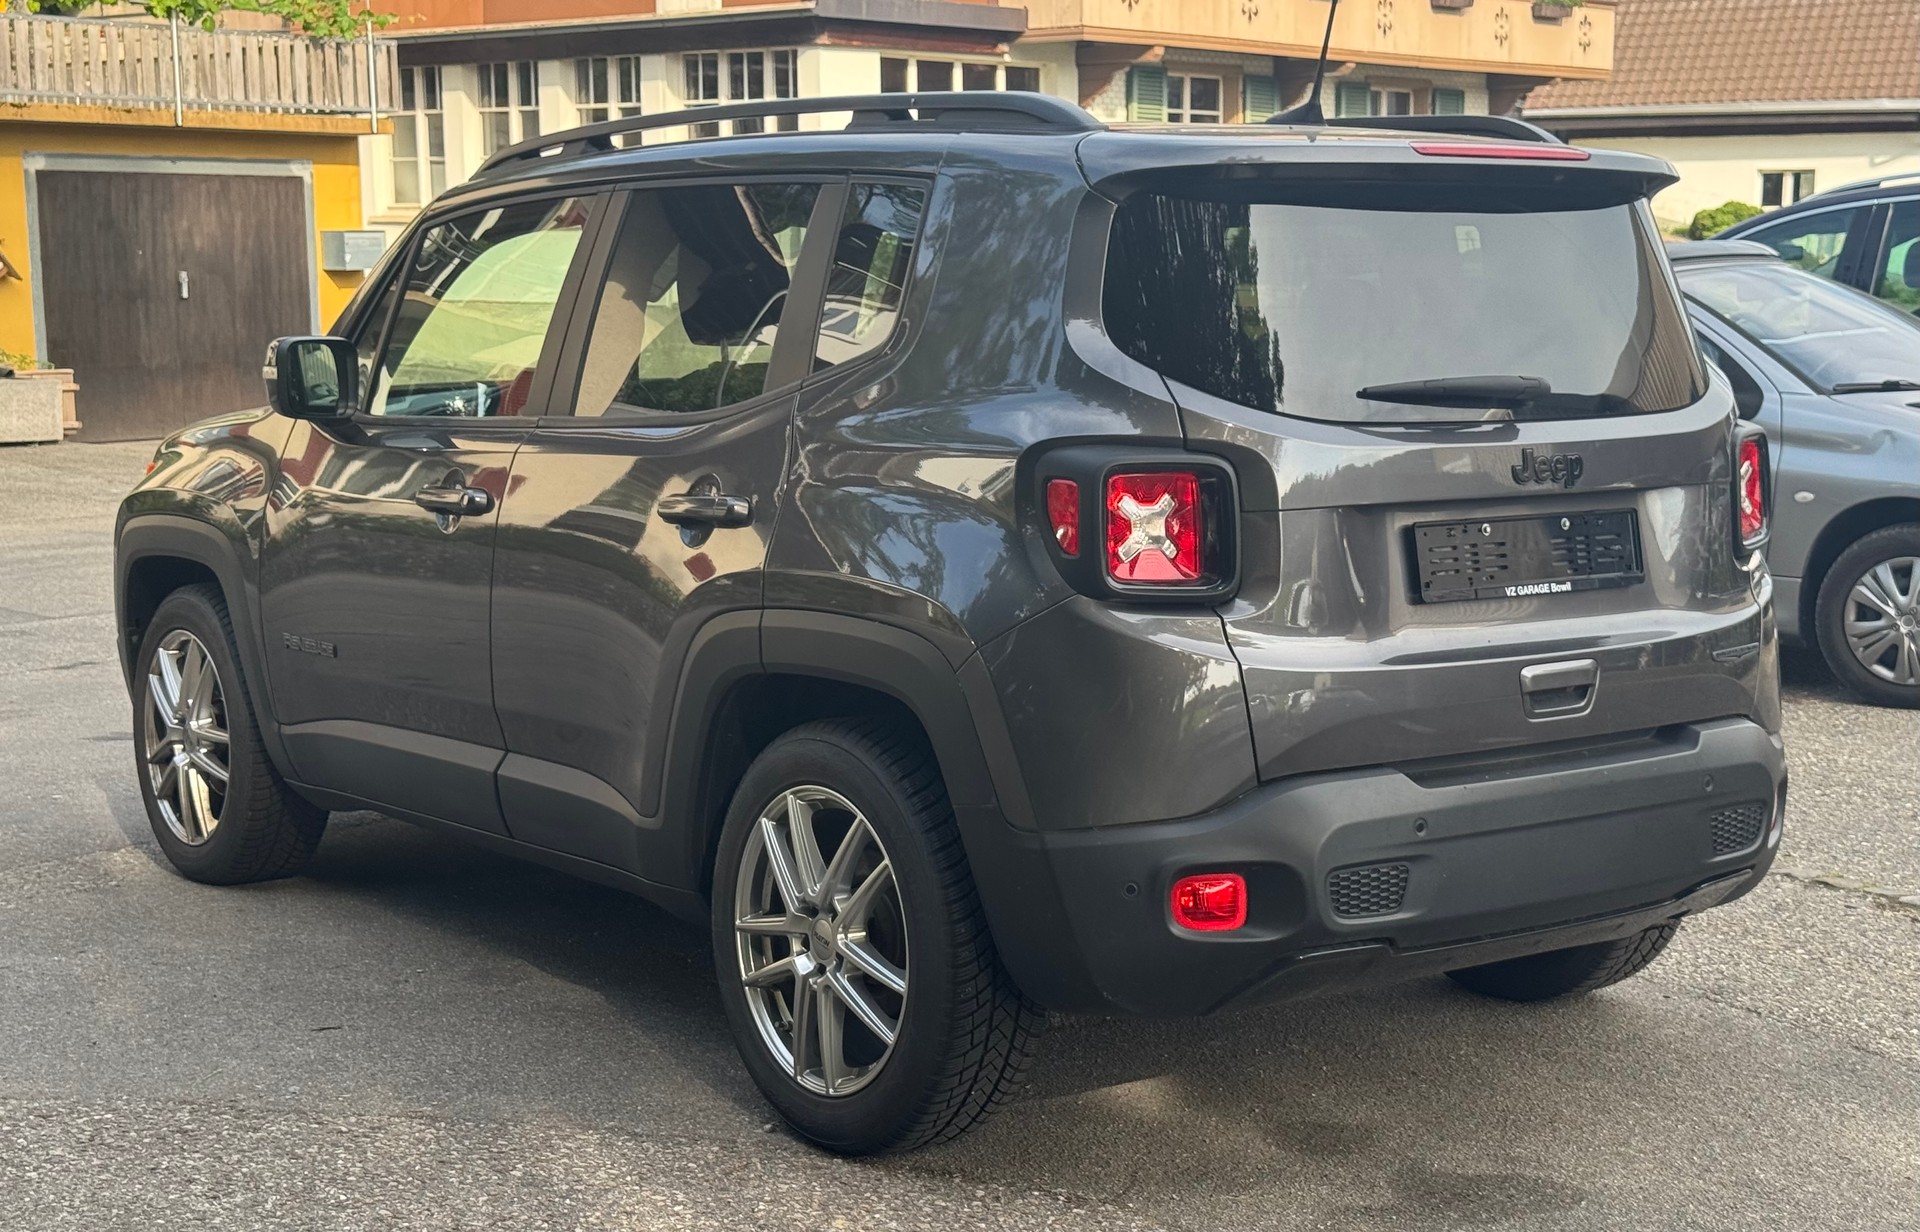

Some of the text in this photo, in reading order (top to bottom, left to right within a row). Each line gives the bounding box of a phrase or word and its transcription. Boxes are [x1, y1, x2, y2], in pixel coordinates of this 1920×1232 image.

[1511, 447, 1584, 489] Jeep
[1504, 586, 1517, 597] VZ
[1517, 583, 1551, 596] GARAGE
